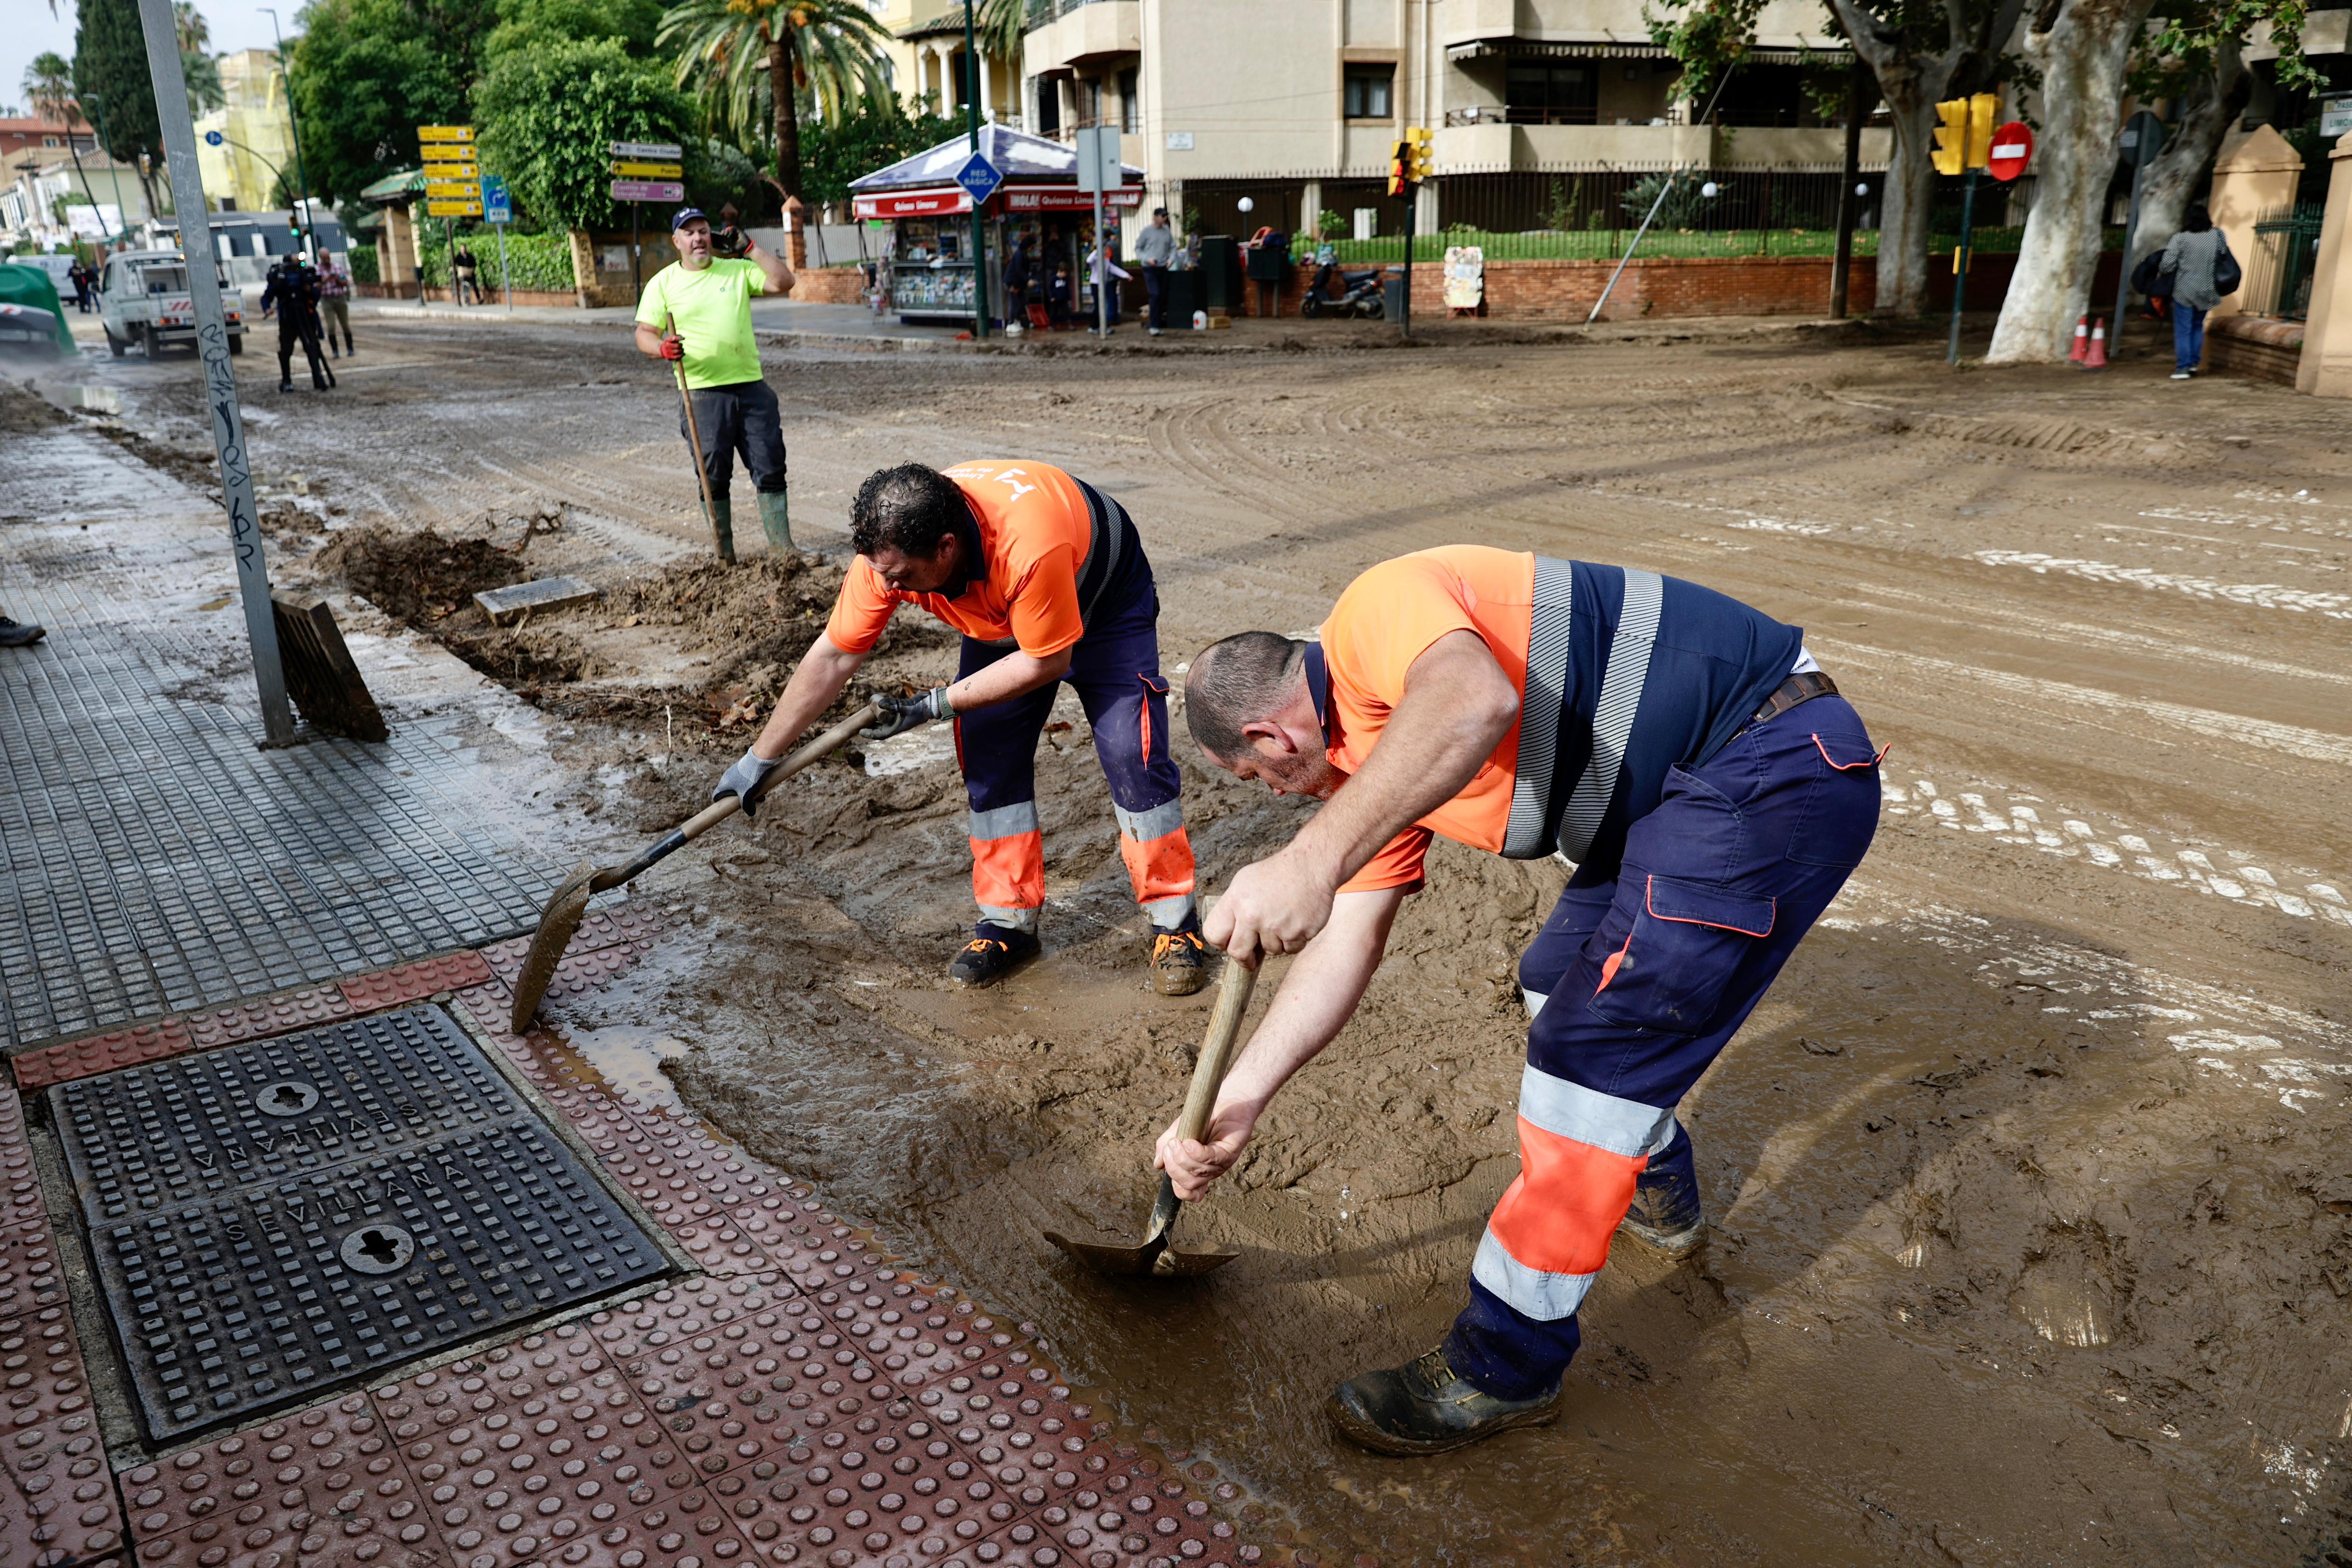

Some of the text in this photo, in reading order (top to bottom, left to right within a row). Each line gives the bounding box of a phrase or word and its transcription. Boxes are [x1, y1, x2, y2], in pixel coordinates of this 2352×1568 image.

[970, 169, 987, 177] RED
[964, 177, 994, 186] BÁSICA
[916, 200, 939, 210] Limonar
[1041, 195, 1073, 205] Quiosco
[195, 1103, 418, 1168] SEVILLANA
[226, 1164, 464, 1241] SEVILLANA
